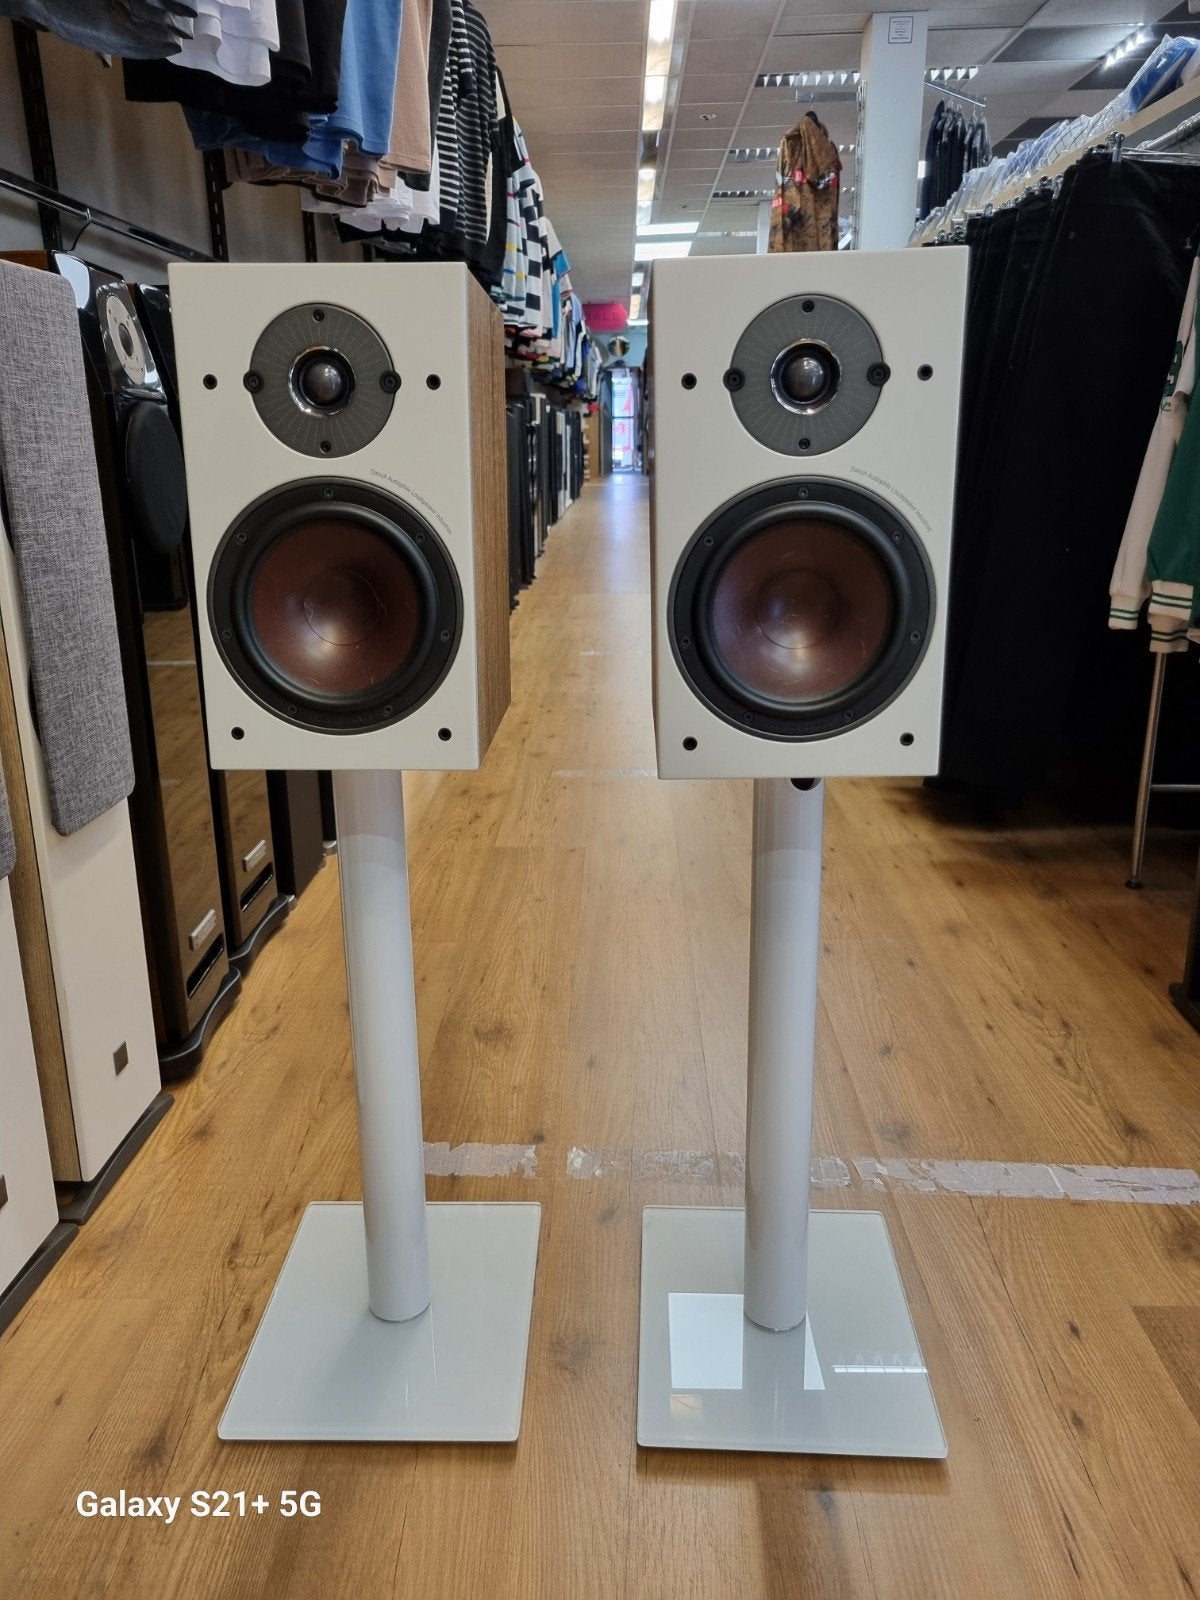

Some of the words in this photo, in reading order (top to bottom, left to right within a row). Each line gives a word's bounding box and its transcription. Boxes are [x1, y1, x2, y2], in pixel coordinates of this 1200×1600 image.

[370, 468, 387, 479] Danish
[387, 475, 411, 493] Audiophile
[411, 490, 437, 514] Loudspeaker
[436, 512, 452, 535] Industries
[849, 465, 868, 477] Danish
[868, 472, 892, 489] Audiophile
[891, 486, 917, 511] Loudspeaker
